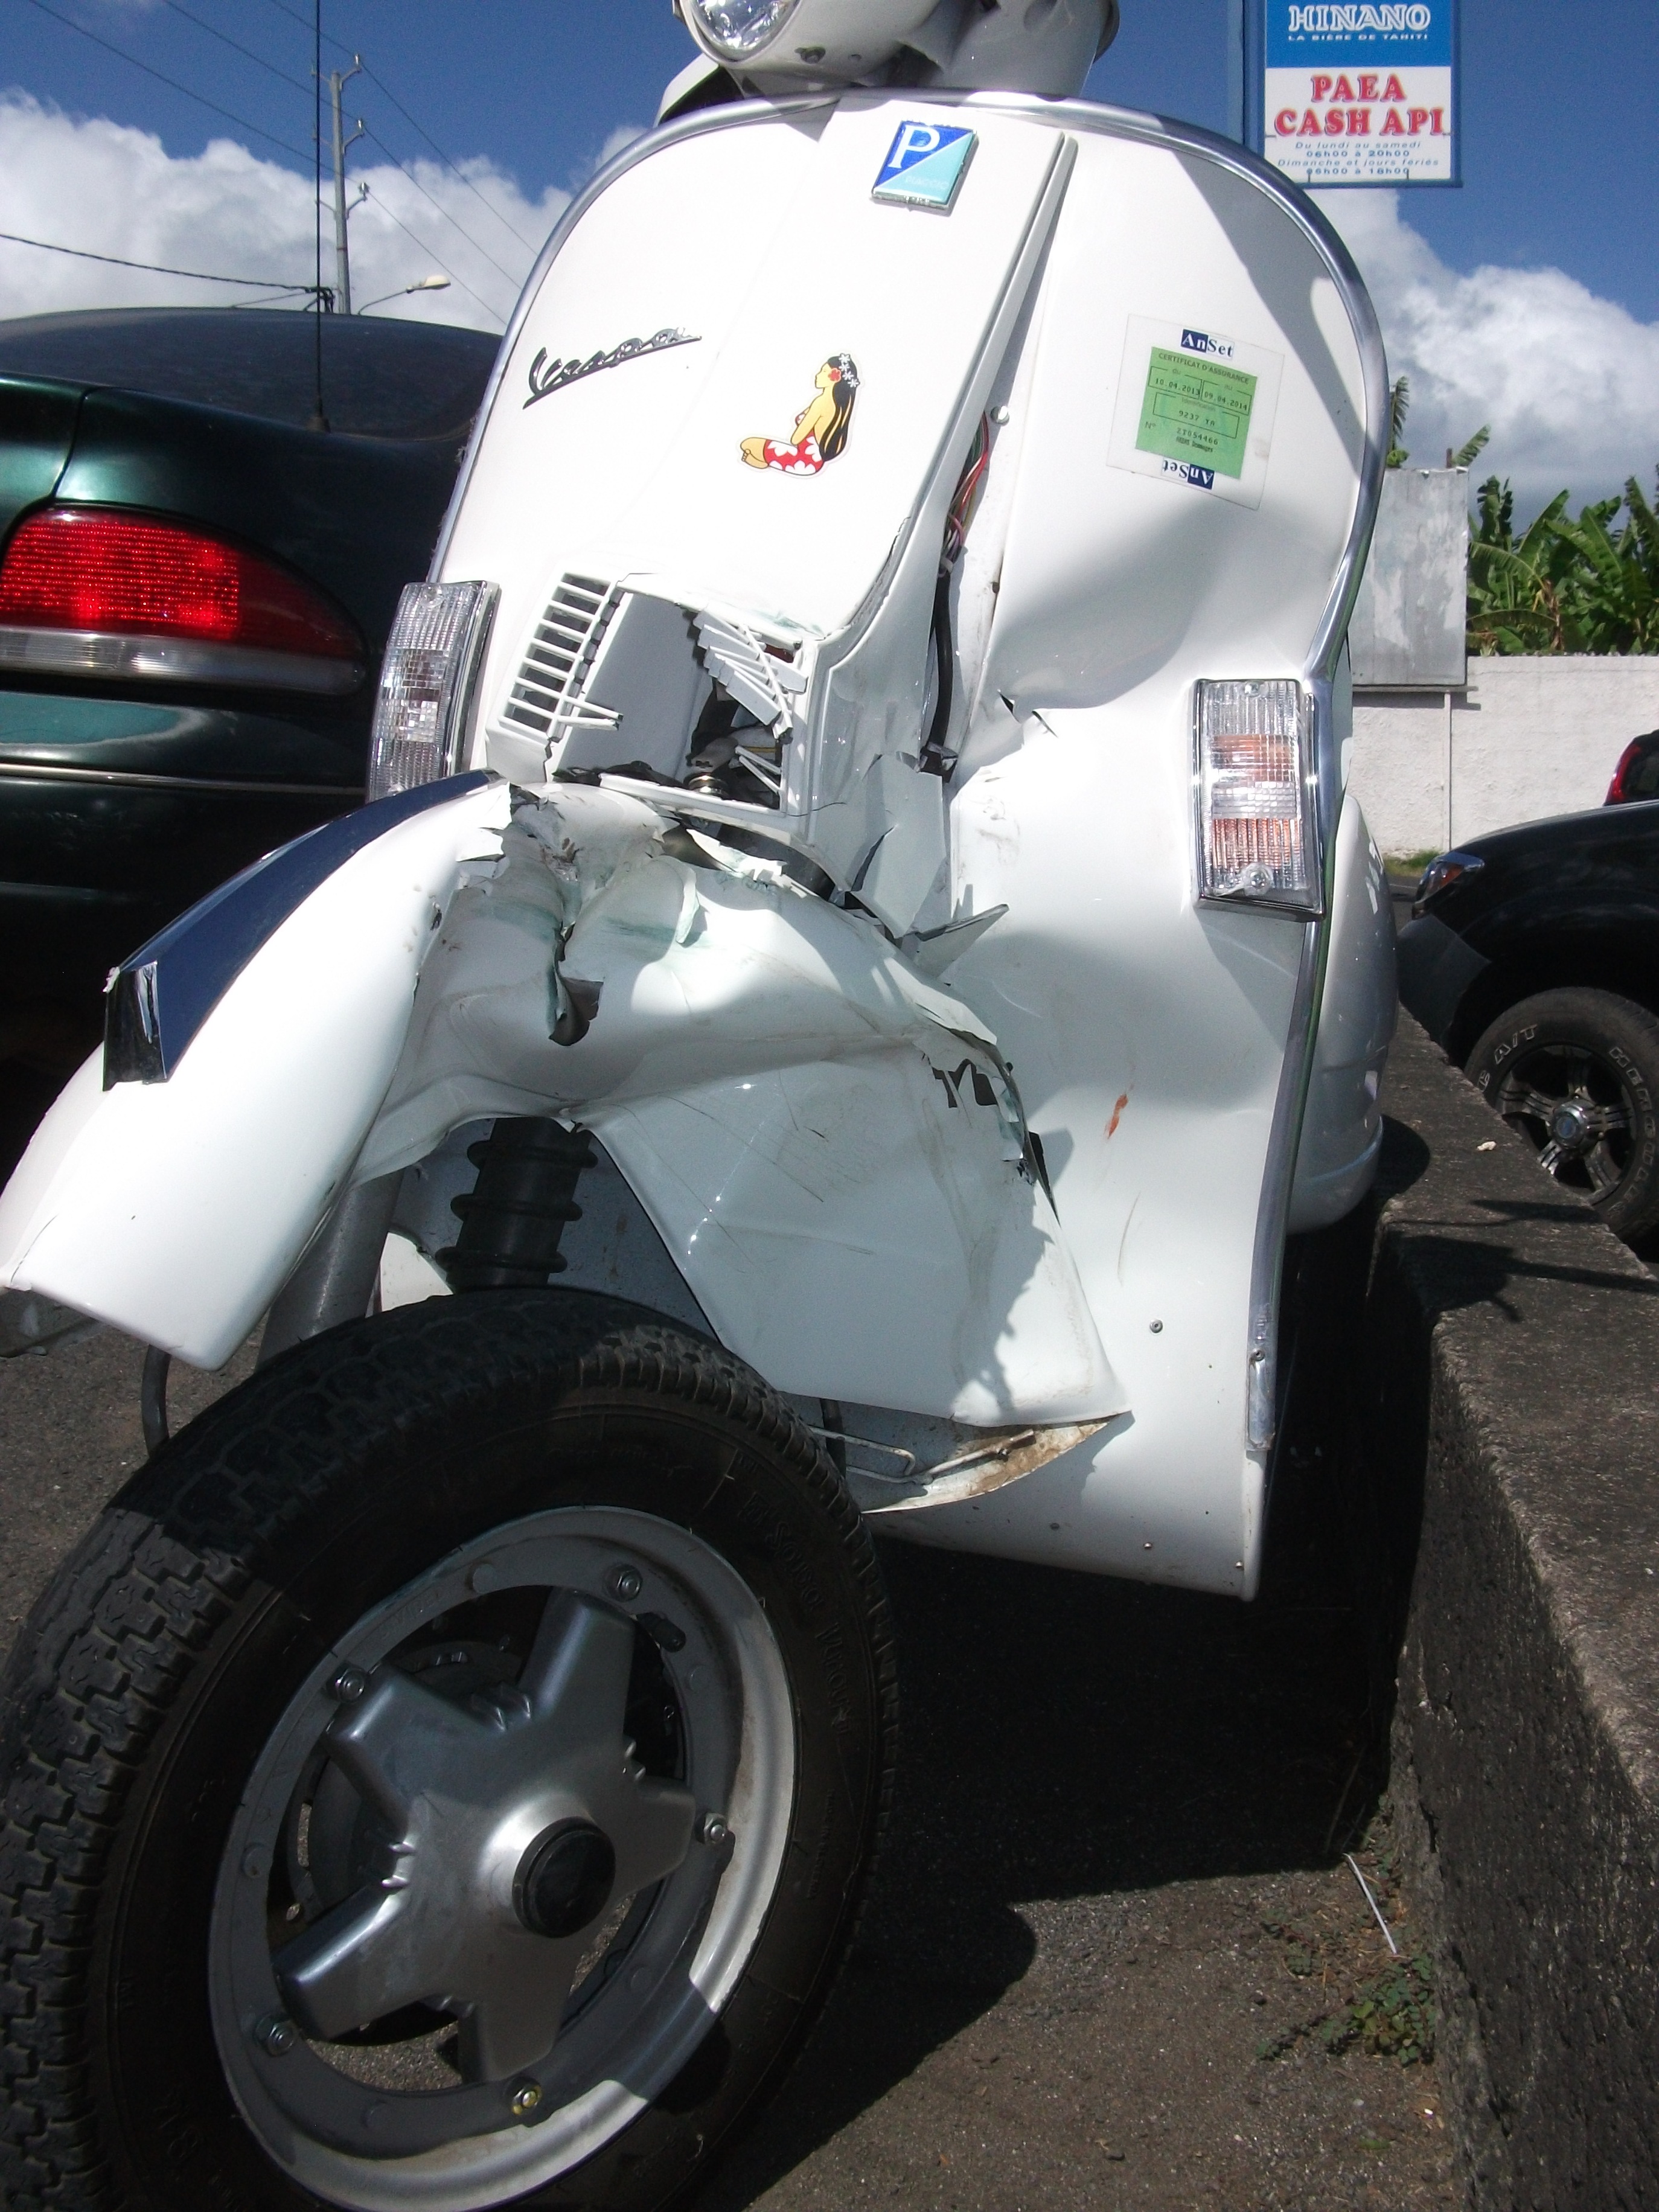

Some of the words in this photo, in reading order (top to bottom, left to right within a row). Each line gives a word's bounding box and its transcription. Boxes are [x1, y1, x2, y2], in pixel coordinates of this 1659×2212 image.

[1288, 4, 1431, 31] HINANO
[1311, 73, 1407, 103] PAEA
[1274, 107, 1371, 138] CASH
[1379, 107, 1445, 136] API
[1363, 159, 1396, 167] jours
[1181, 331, 1234, 357] AnSet
[522, 327, 702, 411] Vespa
[1159, 353, 1200, 368] CERTIFICAT
[1178, 410, 1200, 421] 9237
[1163, 459, 1214, 485] AnSet
